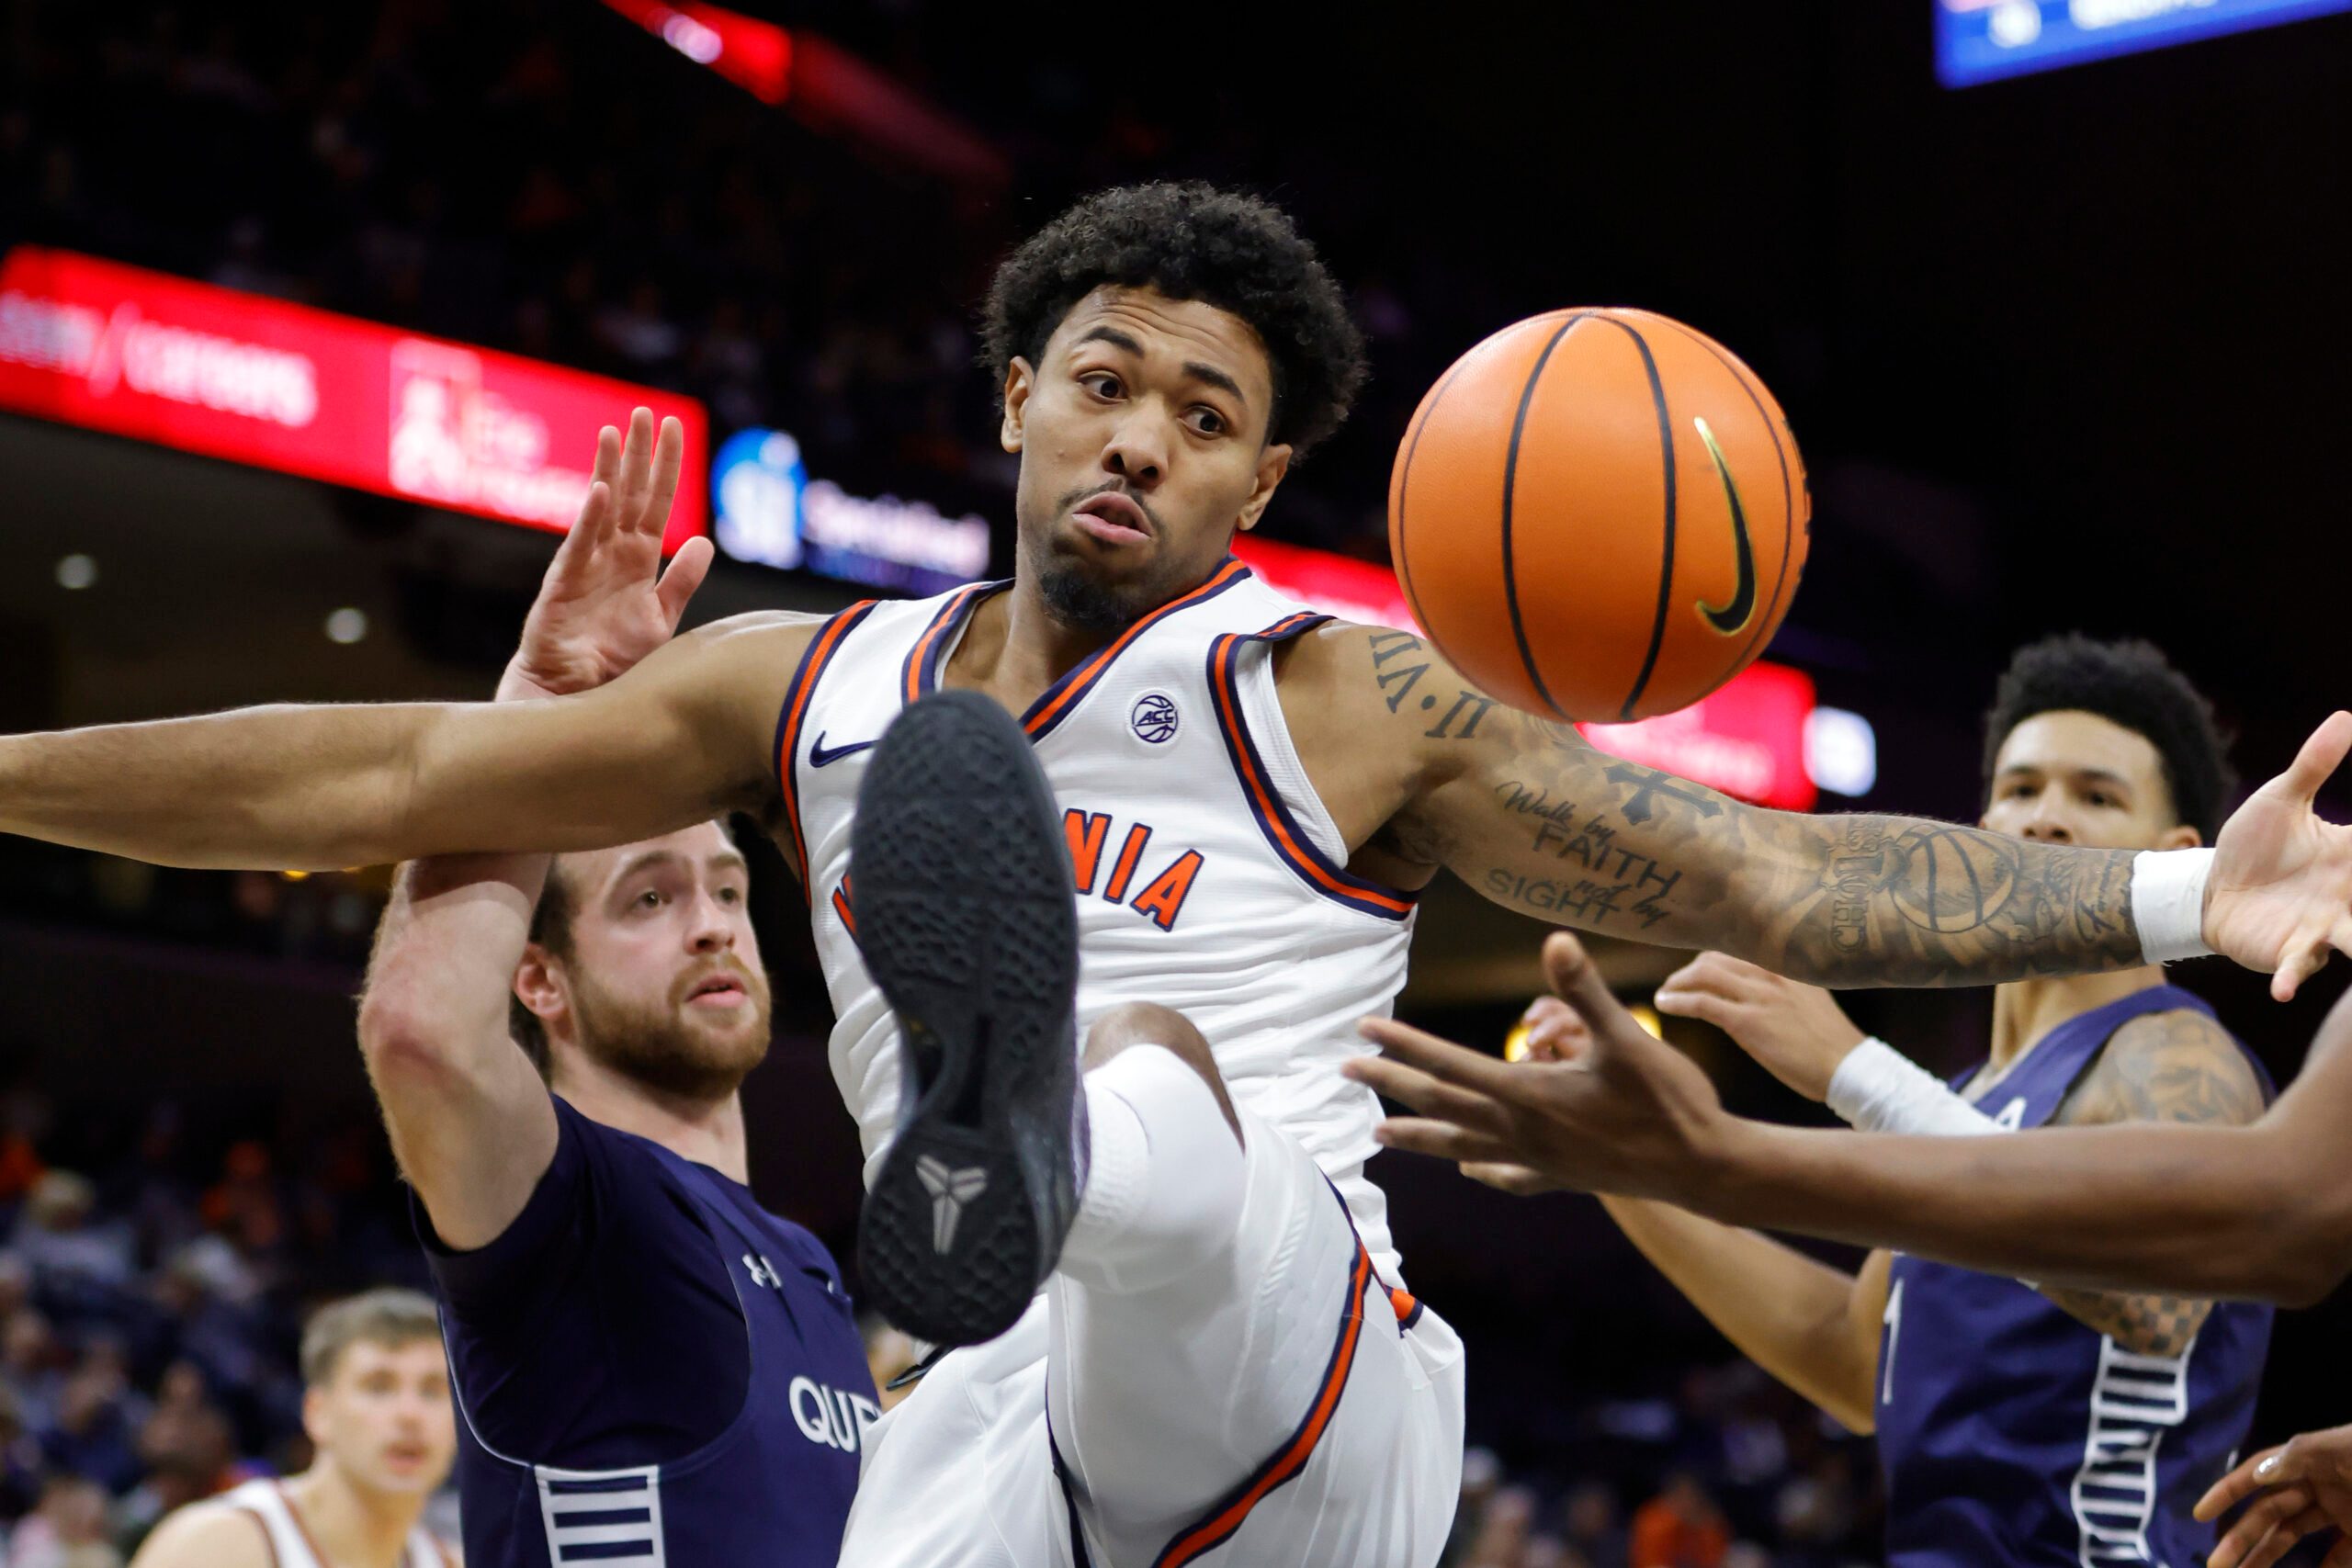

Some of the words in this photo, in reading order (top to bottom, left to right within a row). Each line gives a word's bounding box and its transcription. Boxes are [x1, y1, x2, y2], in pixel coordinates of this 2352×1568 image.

[1136, 707, 1175, 725] ACC
[1532, 821, 1683, 897] FAITH
[1486, 868, 1622, 925] SIGHT
[789, 1376, 883, 1453] QUE
